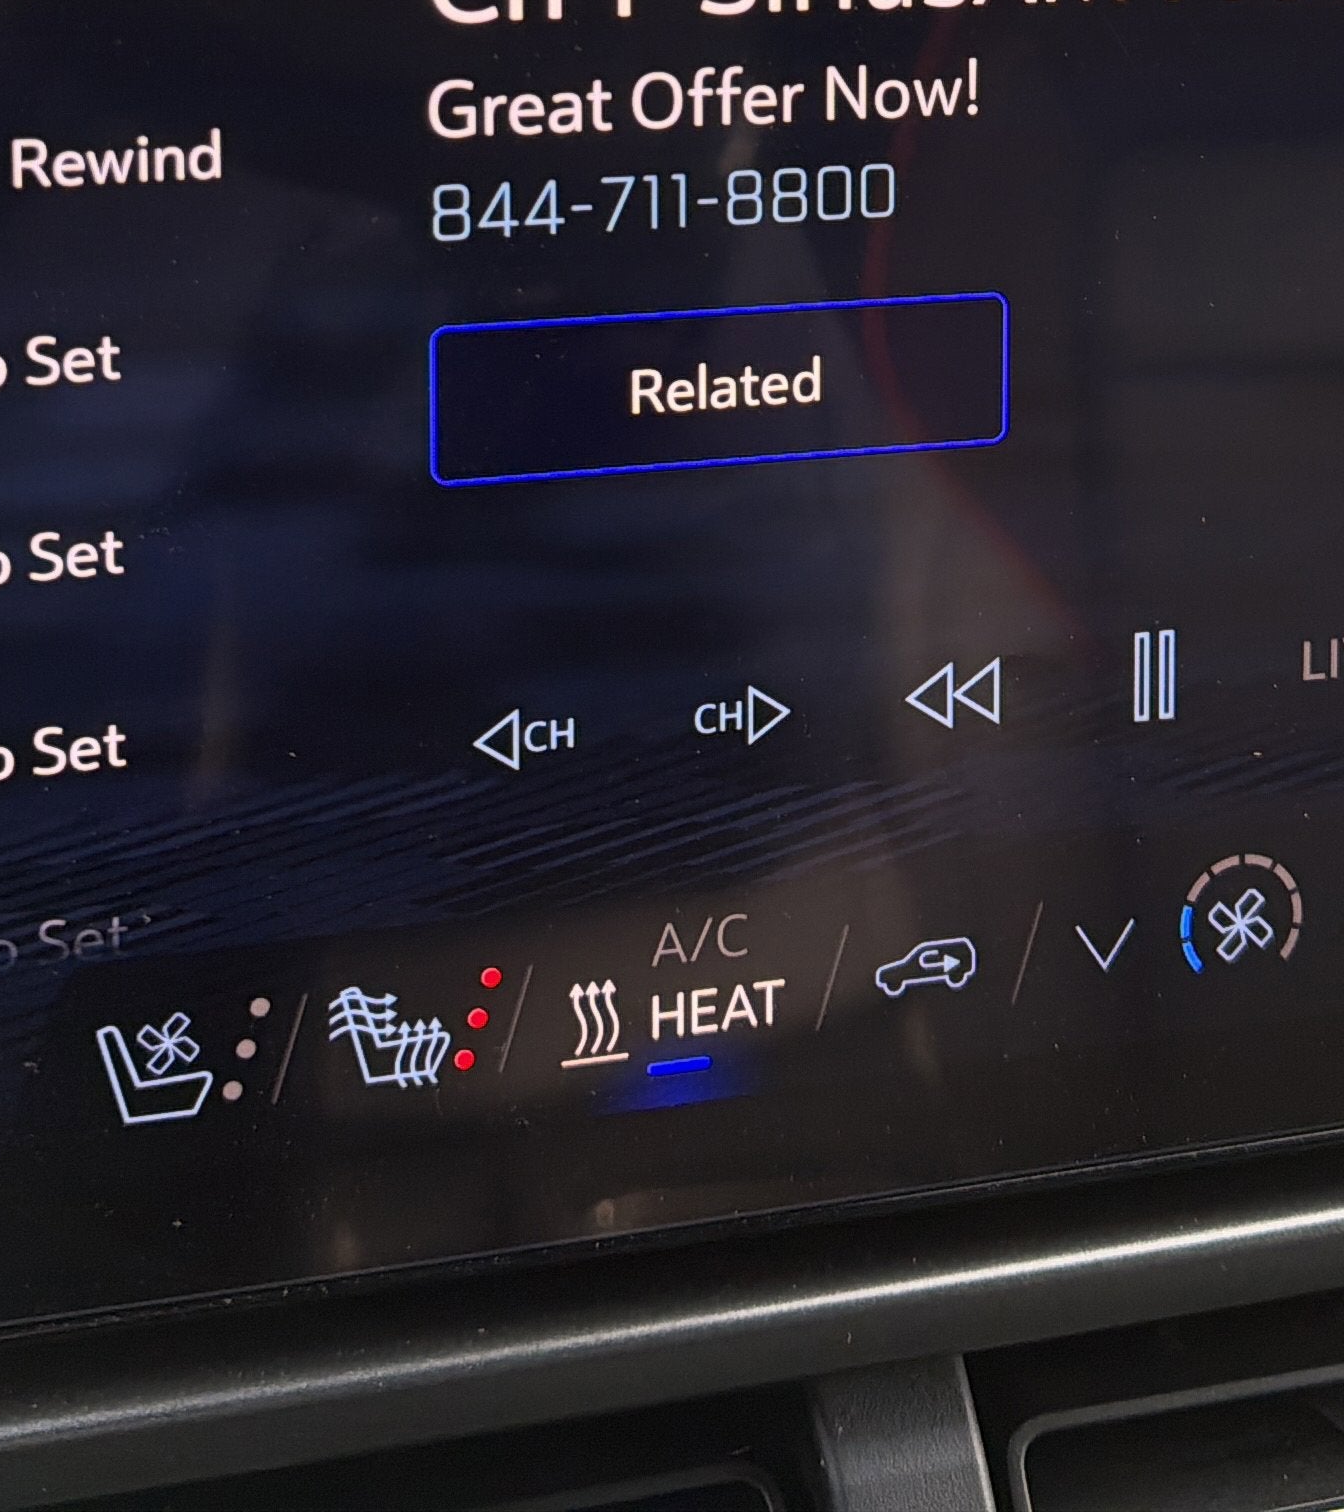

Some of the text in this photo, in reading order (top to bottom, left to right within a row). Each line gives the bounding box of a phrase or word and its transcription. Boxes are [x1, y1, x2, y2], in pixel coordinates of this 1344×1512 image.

[428, 57, 979, 139] Great Offer Now!
[11, 127, 222, 189] Rewind
[432, 163, 895, 242] 844-711-8800
[25, 335, 122, 386] Set
[631, 354, 821, 415] Related
[29, 531, 125, 582] Set
[523, 717, 575, 753] CH
[694, 700, 743, 734] CH
[32, 724, 127, 776] Set
[38, 916, 130, 960] Set
[651, 913, 748, 967] A/C
[651, 978, 786, 1041] HEAT
